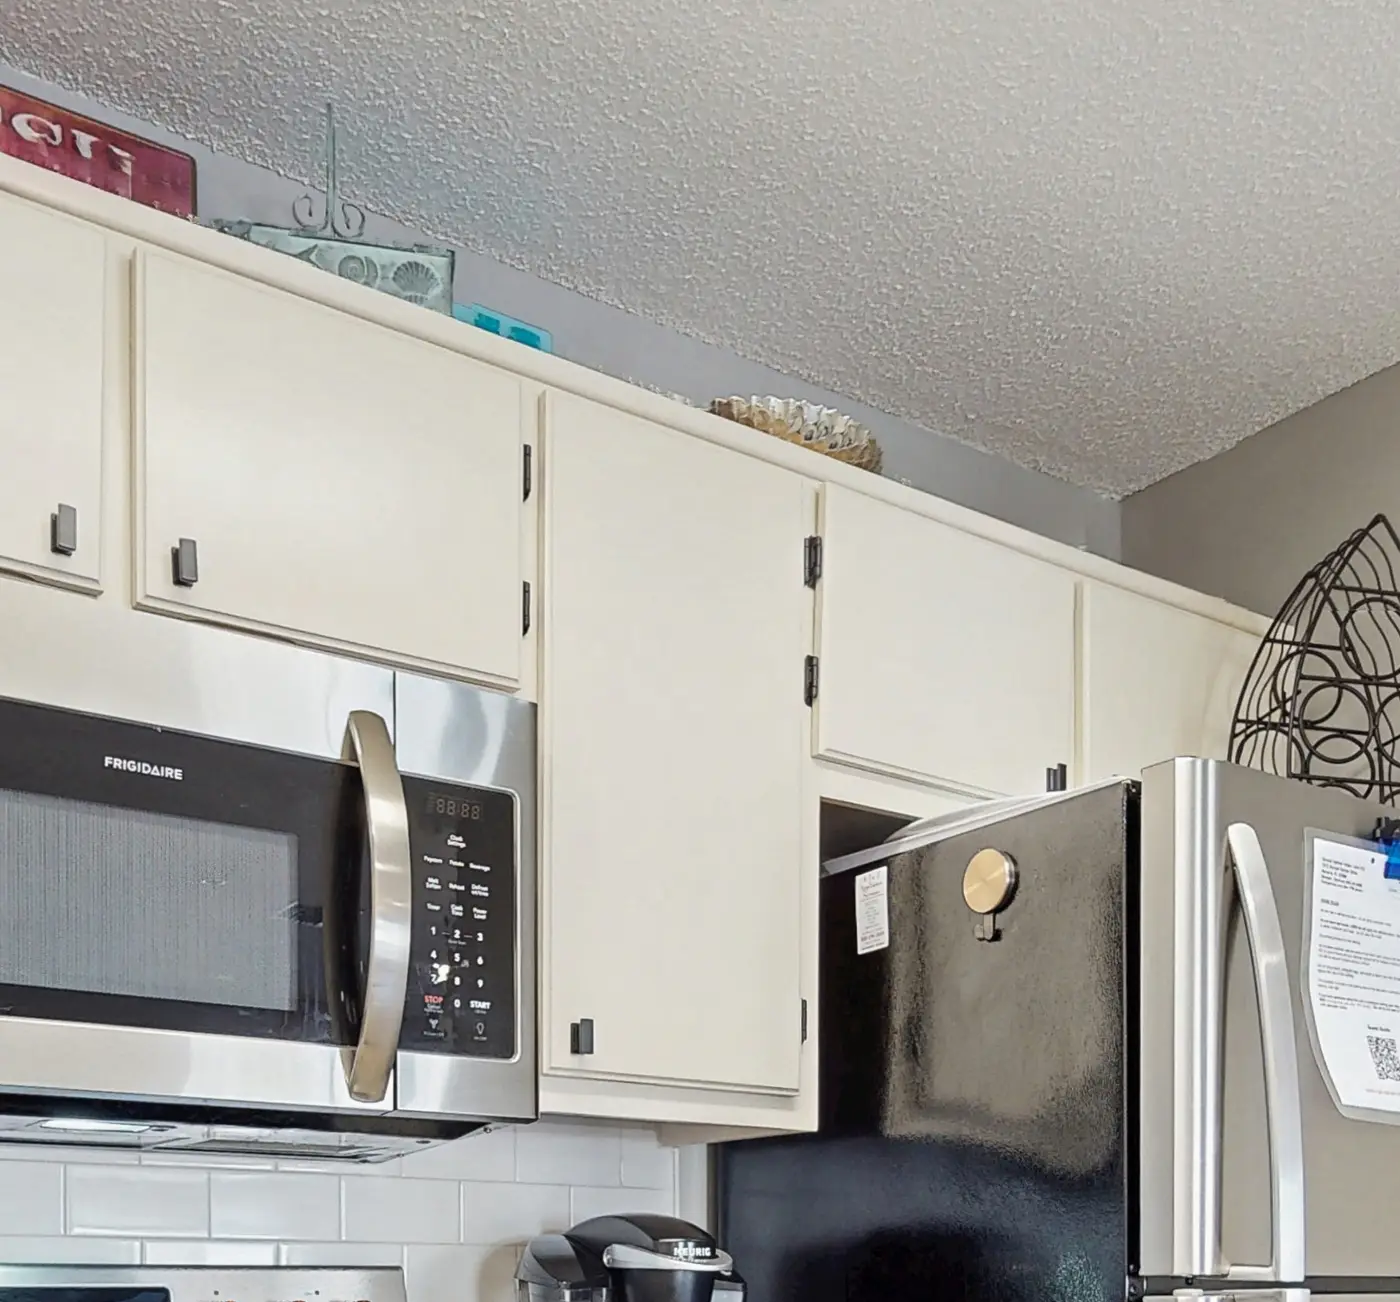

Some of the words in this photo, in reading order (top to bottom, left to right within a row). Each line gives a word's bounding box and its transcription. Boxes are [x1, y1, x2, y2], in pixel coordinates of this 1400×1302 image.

[104, 756, 183, 780] FRIGIDAIRE
[430, 926, 436, 935] 1
[453, 929, 461, 939] 2
[476, 932, 484, 942] 3
[430, 949, 437, 959] 4
[453, 952, 460, 962] 5
[476, 955, 484, 965] 6
[454, 976, 461, 986] 8
[477, 979, 484, 988] 9
[424, 995, 444, 1004] STOP
[453, 998, 461, 1008] 0
[469, 1000, 491, 1010] START
[673, 1247, 711, 1257] KEURIG
